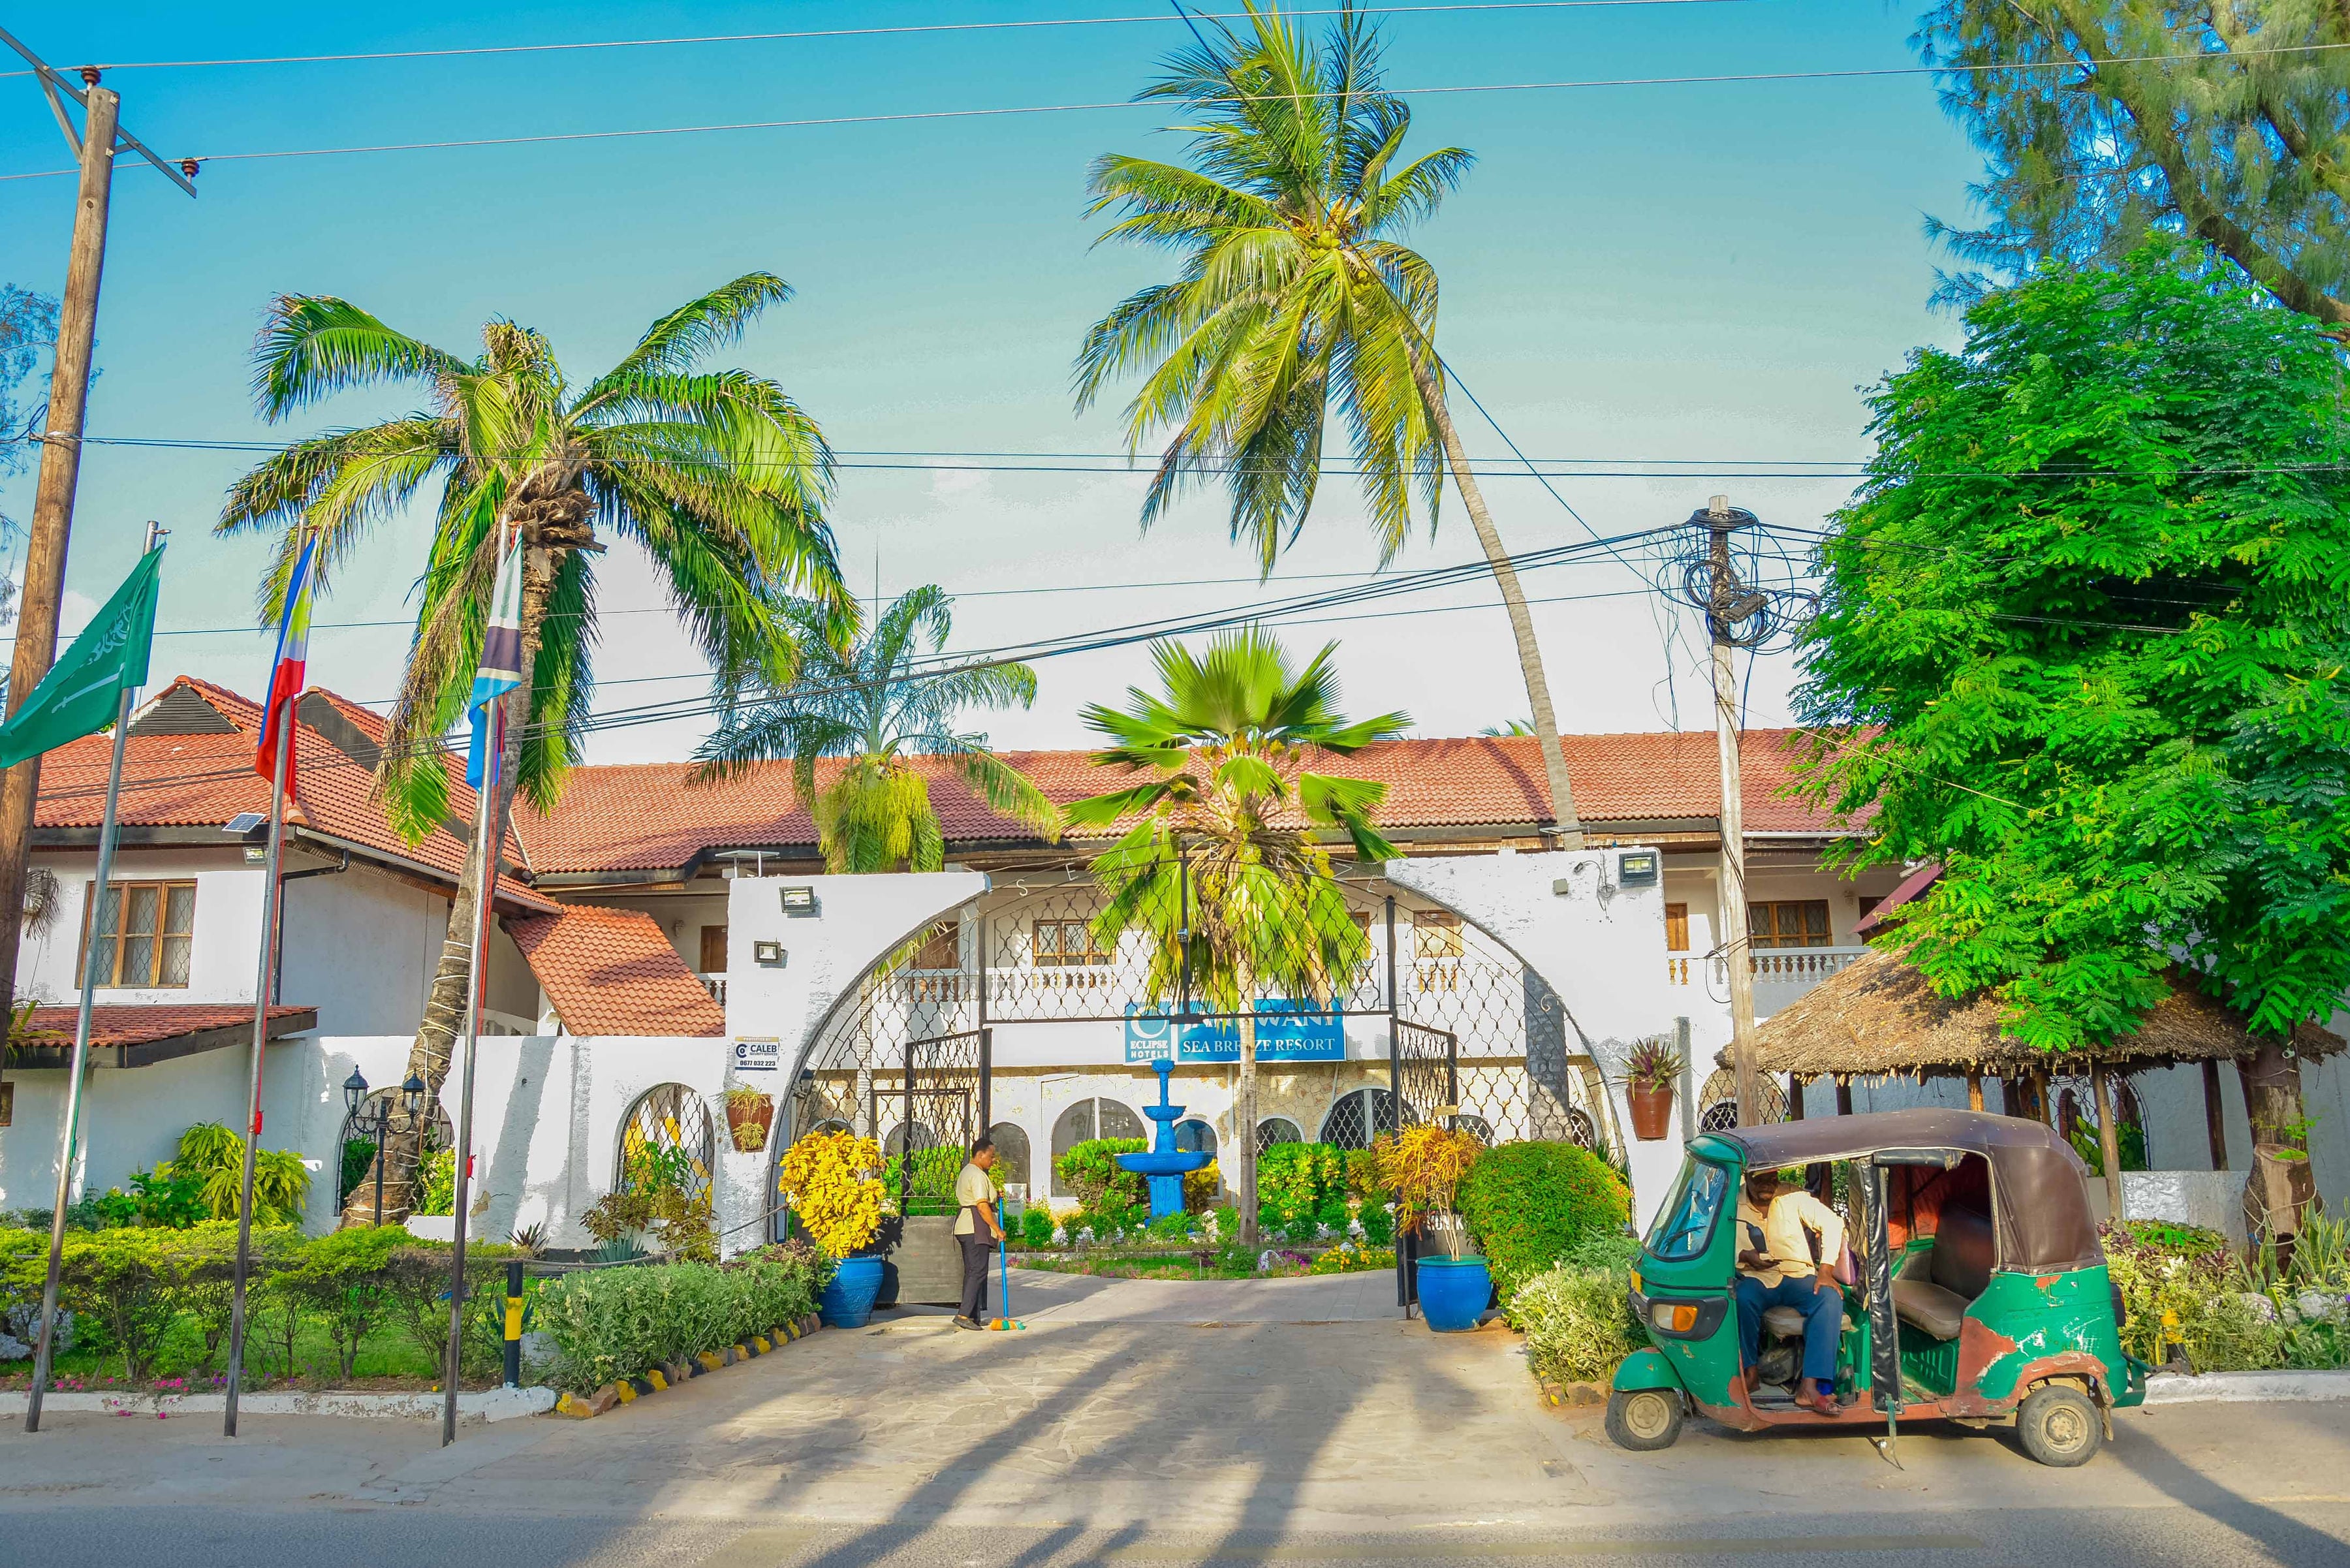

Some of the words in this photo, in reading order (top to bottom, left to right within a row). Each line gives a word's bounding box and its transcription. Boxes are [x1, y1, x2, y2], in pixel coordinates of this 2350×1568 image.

[1130, 1040, 1168, 1050] ECLIPSE
[1183, 1040, 1213, 1053] SEA
[1214, 1039, 1272, 1052] BREZE
[1276, 1038, 1336, 1052] RESORT
[1131, 1050, 1169, 1059] HOTELS
